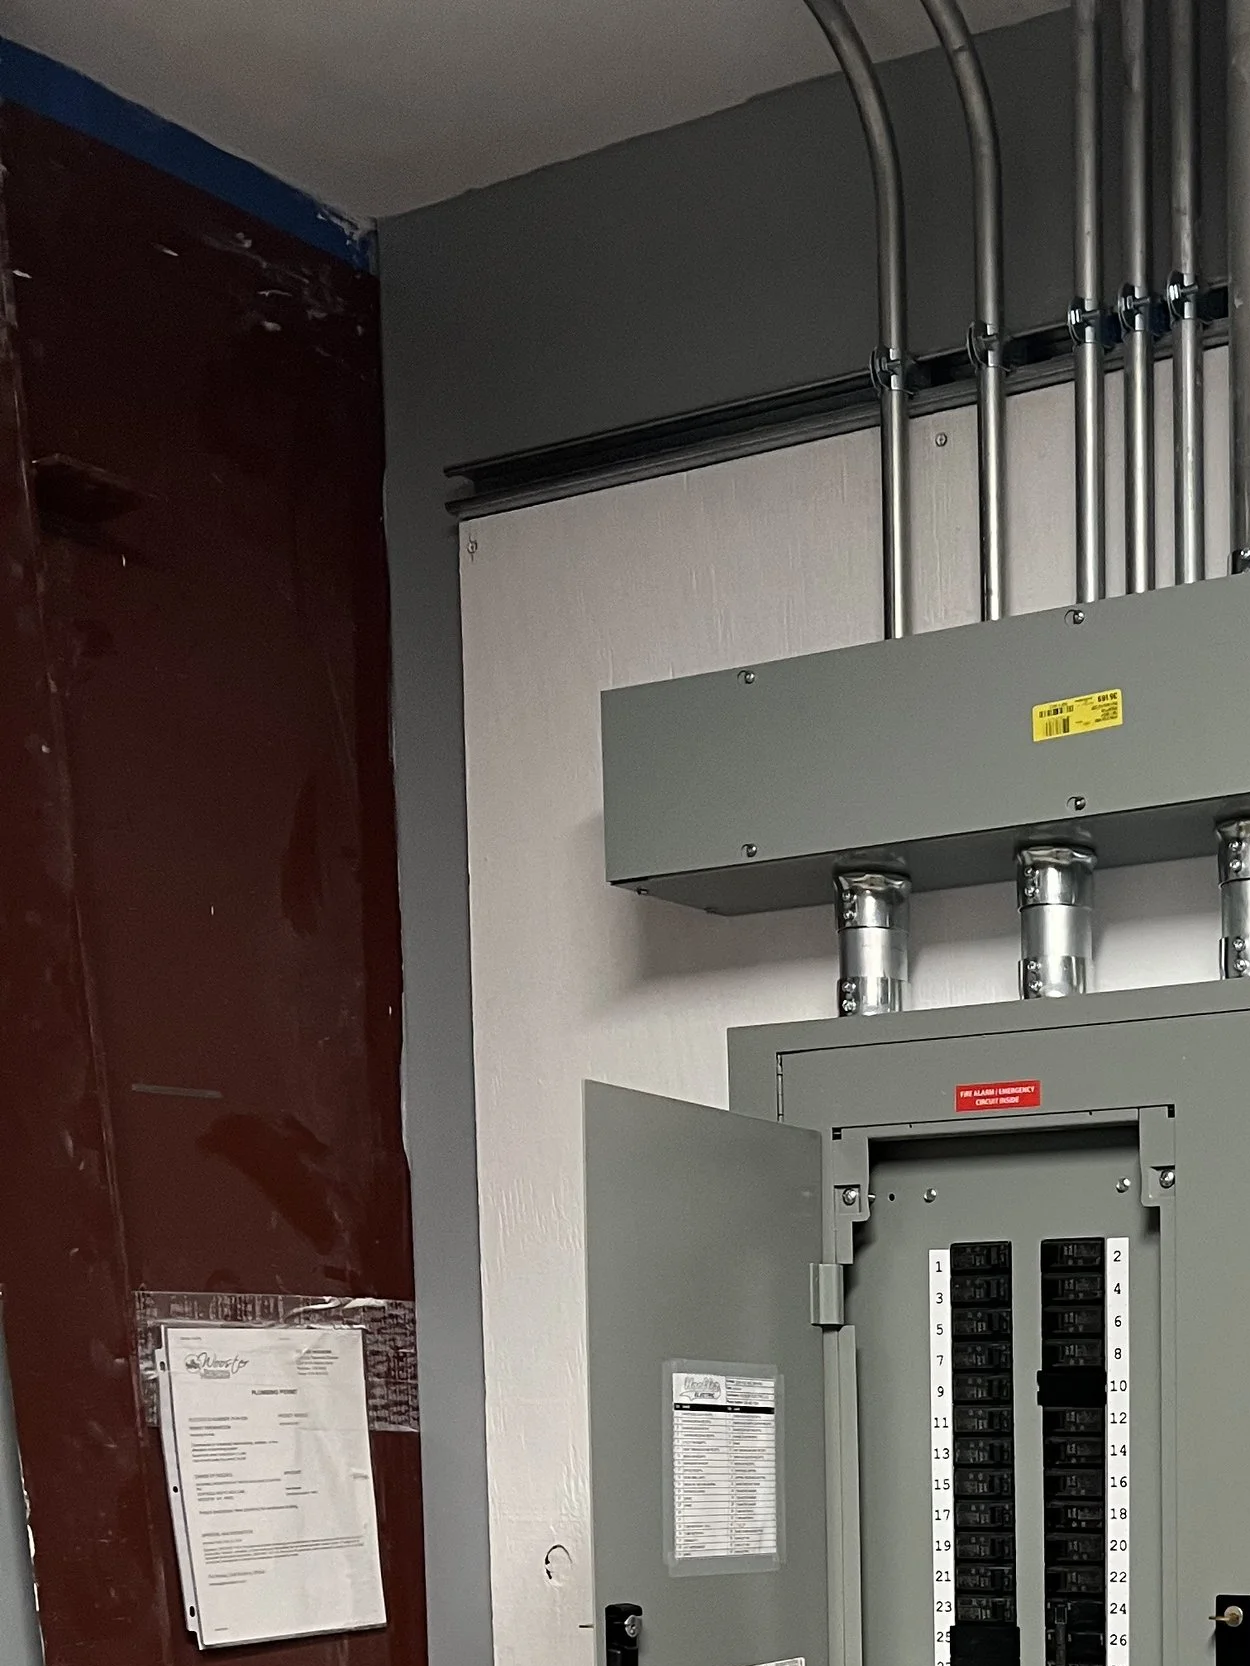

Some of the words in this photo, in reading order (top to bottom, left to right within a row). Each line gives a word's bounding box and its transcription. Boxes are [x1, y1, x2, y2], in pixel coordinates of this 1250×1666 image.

[974, 1089, 995, 1097] ALARM
[999, 1086, 1035, 1095] EMERGENCY
[975, 1097, 999, 1106] CIRCUIT
[1114, 1251, 1121, 1262] 2
[936, 1261, 942, 1272] 1
[1113, 1283, 1121, 1294] 4
[936, 1293, 943, 1304] 3
[1114, 1316, 1121, 1327] 6
[937, 1324, 943, 1335] 5
[1114, 1348, 1121, 1359] 8
[937, 1355, 943, 1366] 7
[1110, 1380, 1127, 1391] 10
[937, 1386, 944, 1397] 9
[934, 1418, 949, 1429] 11
[1110, 1412, 1127, 1424] 12
[934, 1448, 950, 1459] 13
[1110, 1445, 1127, 1456] 14
[935, 1479, 950, 1490] 15
[1110, 1476, 1127, 1487] 16
[935, 1509, 951, 1521] 17
[1110, 1508, 1127, 1520] 18
[935, 1540, 951, 1551] 19
[1110, 1540, 1127, 1551] 20
[936, 1571, 951, 1582] 21
[1110, 1571, 1127, 1583] 22
[936, 1601, 952, 1612] 23
[1110, 1603, 1127, 1614] 24
[1110, 1634, 1127, 1646] 26
